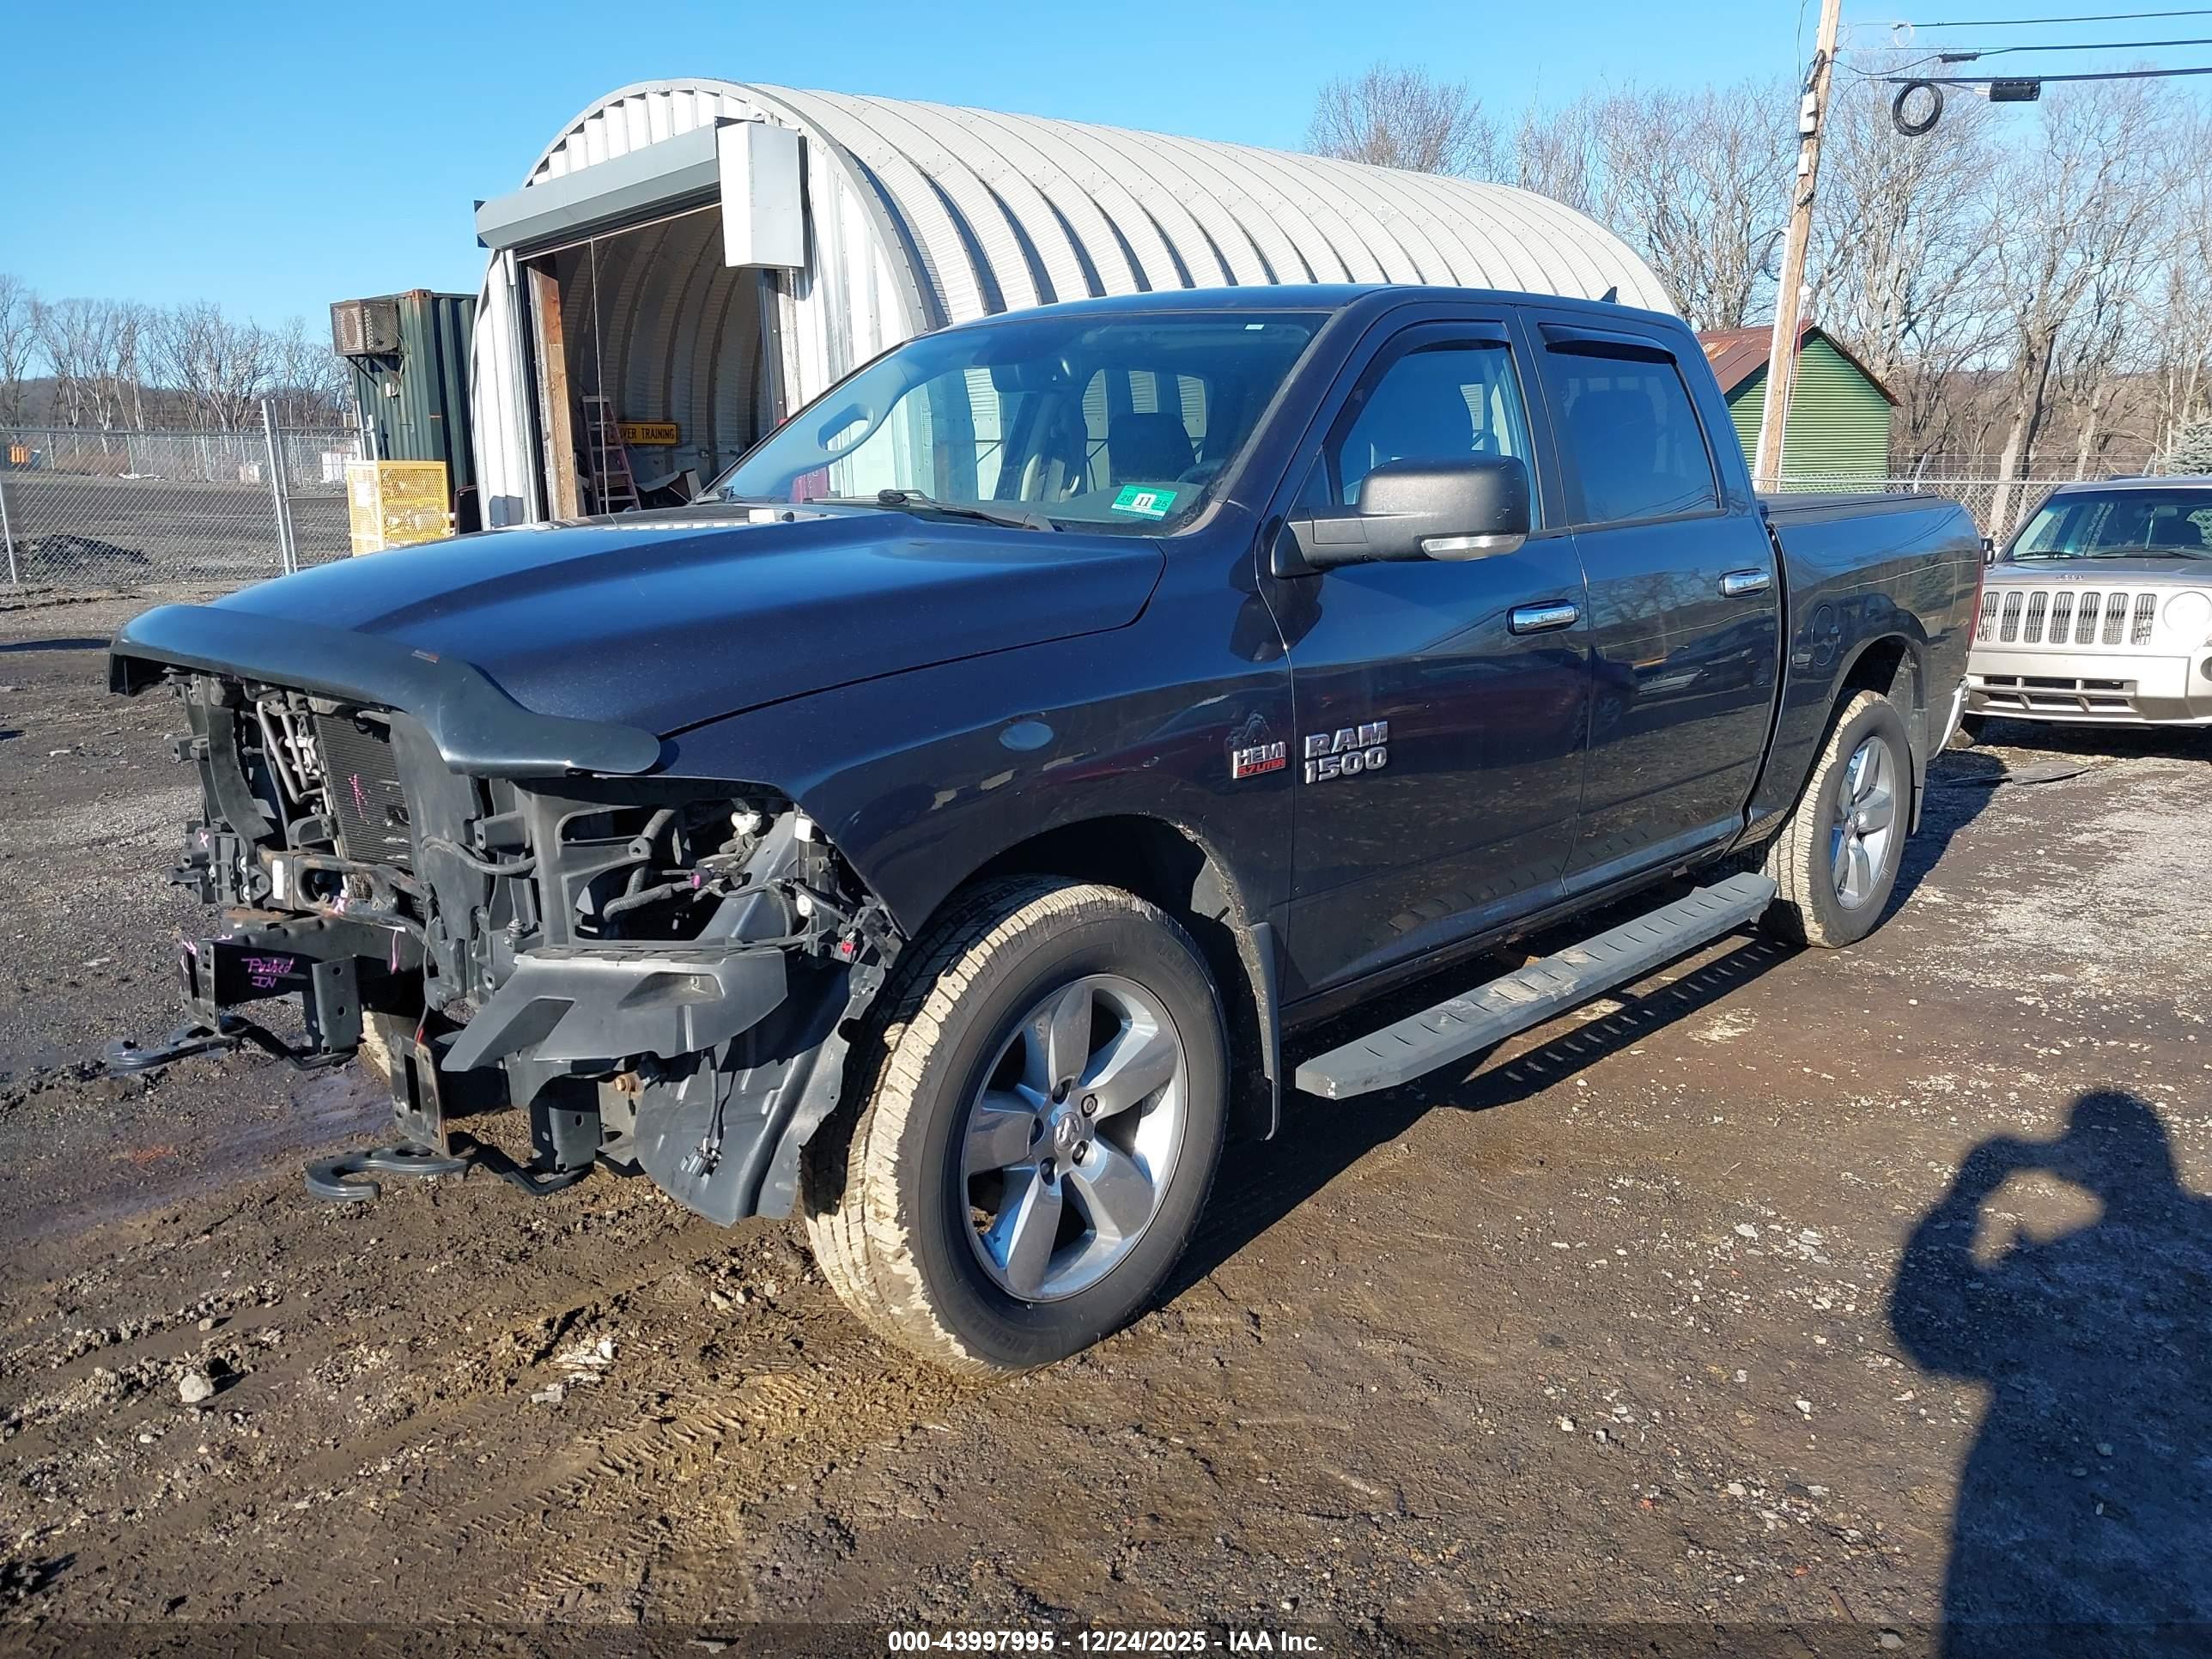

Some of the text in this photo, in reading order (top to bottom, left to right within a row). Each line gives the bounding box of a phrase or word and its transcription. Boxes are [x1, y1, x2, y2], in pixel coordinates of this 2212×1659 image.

[641, 428, 674, 440] TRAINING
[1136, 496, 1152, 507] 11
[1154, 499, 1168, 507] 25
[1305, 721, 1388, 759] RAM
[1233, 742, 1285, 767] HEMI
[1305, 746, 1387, 784] 1500
